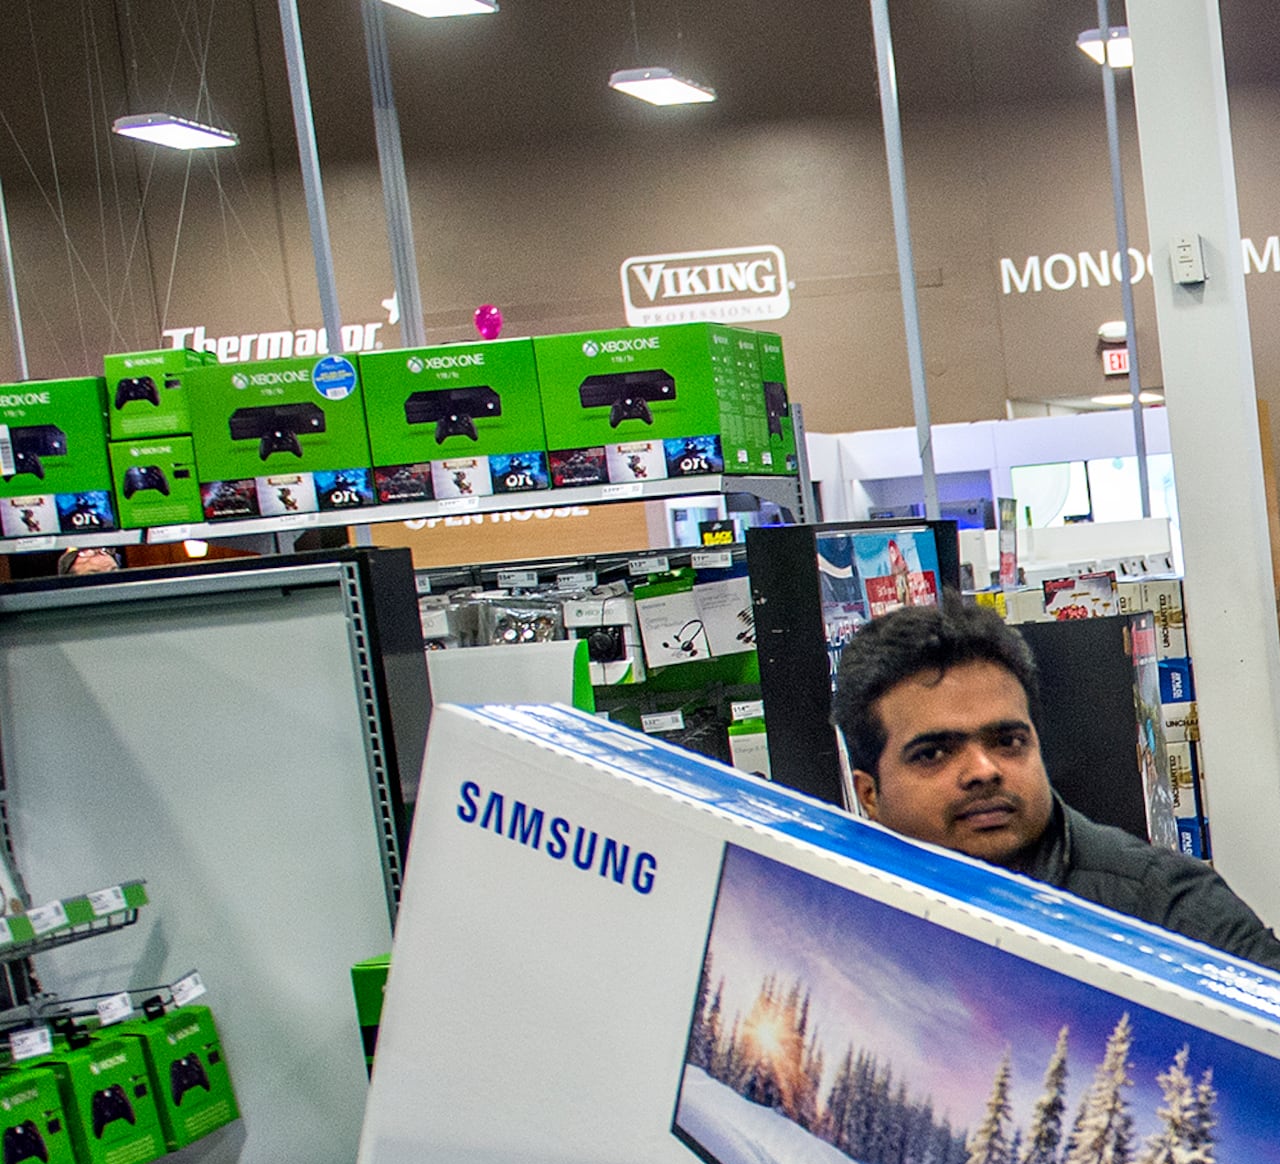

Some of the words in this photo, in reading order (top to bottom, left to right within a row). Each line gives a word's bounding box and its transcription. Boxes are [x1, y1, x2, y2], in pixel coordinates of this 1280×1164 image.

[630, 258, 777, 301] VIKING
[642, 304, 775, 325] PROFESSIONAL
[600, 340, 633, 353] XBOX
[633, 337, 660, 350] ONE
[425, 355, 458, 369] XBOX
[457, 353, 486, 367] ONE
[1108, 350, 1128, 372] EXI
[250, 371, 284, 385] XBOX
[283, 369, 310, 383] ONE
[0, 394, 25, 408] BOX
[24, 392, 51, 406] ONE
[1159, 594, 1170, 648] UNCHARTED
[1169, 755, 1181, 809] UNCHARTED
[456, 779, 660, 896] SAMSUNG
